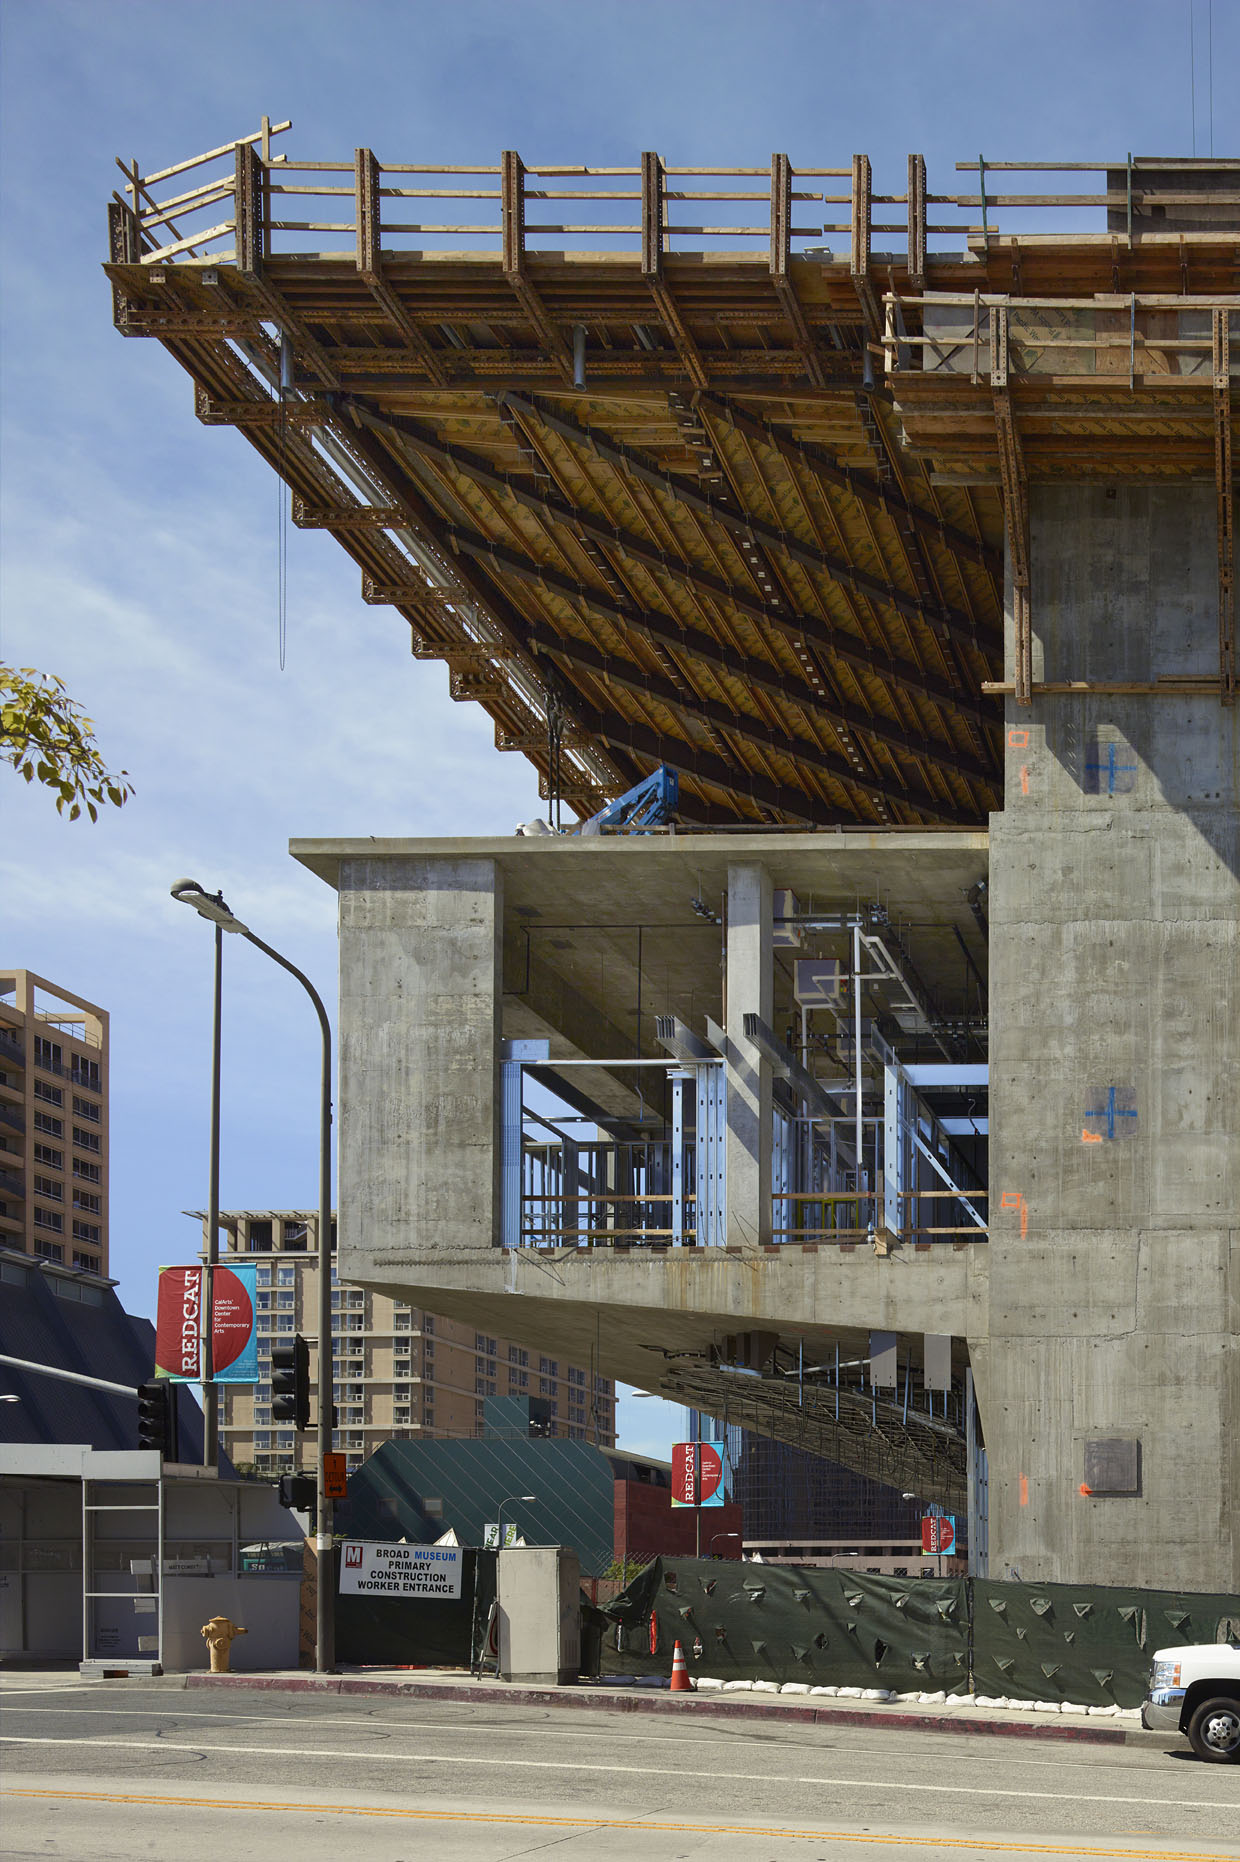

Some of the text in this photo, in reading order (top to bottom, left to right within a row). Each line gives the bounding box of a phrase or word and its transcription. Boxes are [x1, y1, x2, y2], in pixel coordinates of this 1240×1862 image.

[182, 1270, 200, 1372] REDCAT
[685, 1445, 694, 1502] REDCAT
[376, 1549, 457, 1562] BROAD MUSEUM
[388, 1560, 431, 1571] PRIMARY
[370, 1570, 447, 1583] CONSTRUCTION
[357, 1580, 455, 1594] WORKER ENTRANCE
